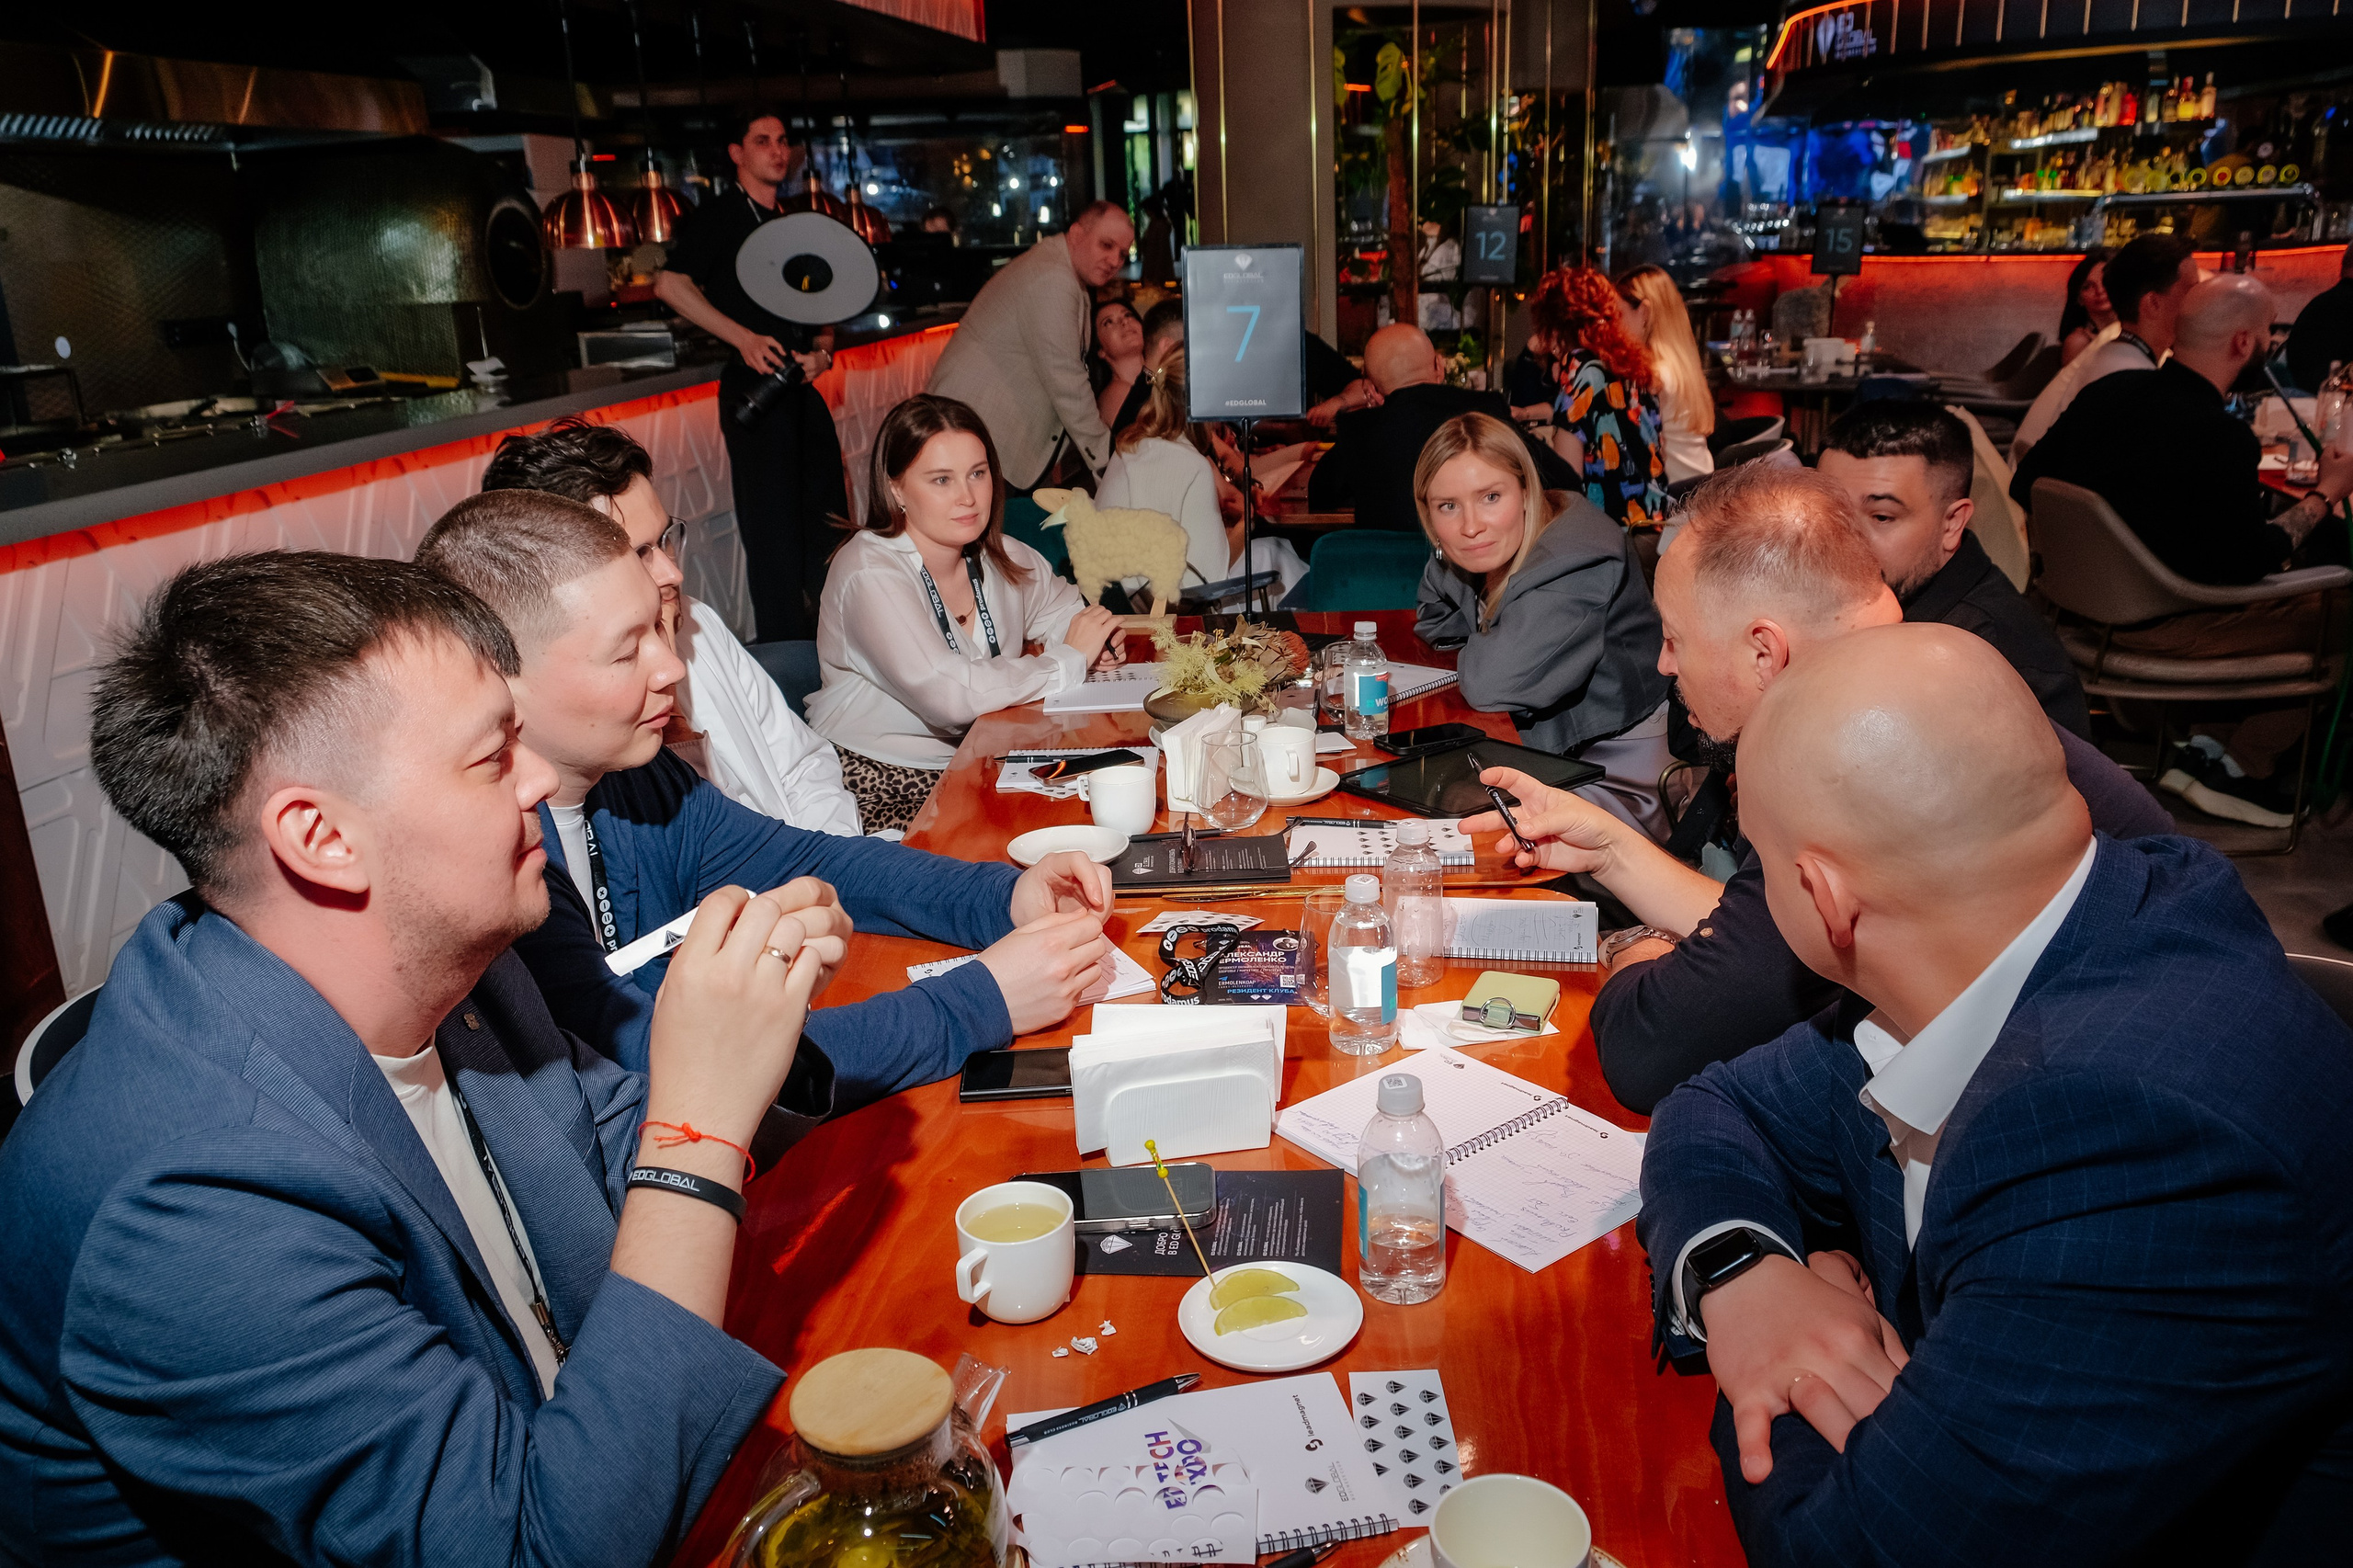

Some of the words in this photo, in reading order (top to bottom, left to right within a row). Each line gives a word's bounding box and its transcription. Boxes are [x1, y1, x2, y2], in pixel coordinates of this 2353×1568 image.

[1475, 231, 1506, 260] 12
[1824, 228, 1853, 253] 15
[1226, 305, 1260, 362] 7
[1375, 696, 1389, 707] WO
[631, 1169, 700, 1192] EDGLOBAL
[1154, 1233, 1168, 1256] ДОБРО
[1078, 1406, 1118, 1423] EDGLOBAL
[1292, 1394, 1315, 1437] leadmagnet
